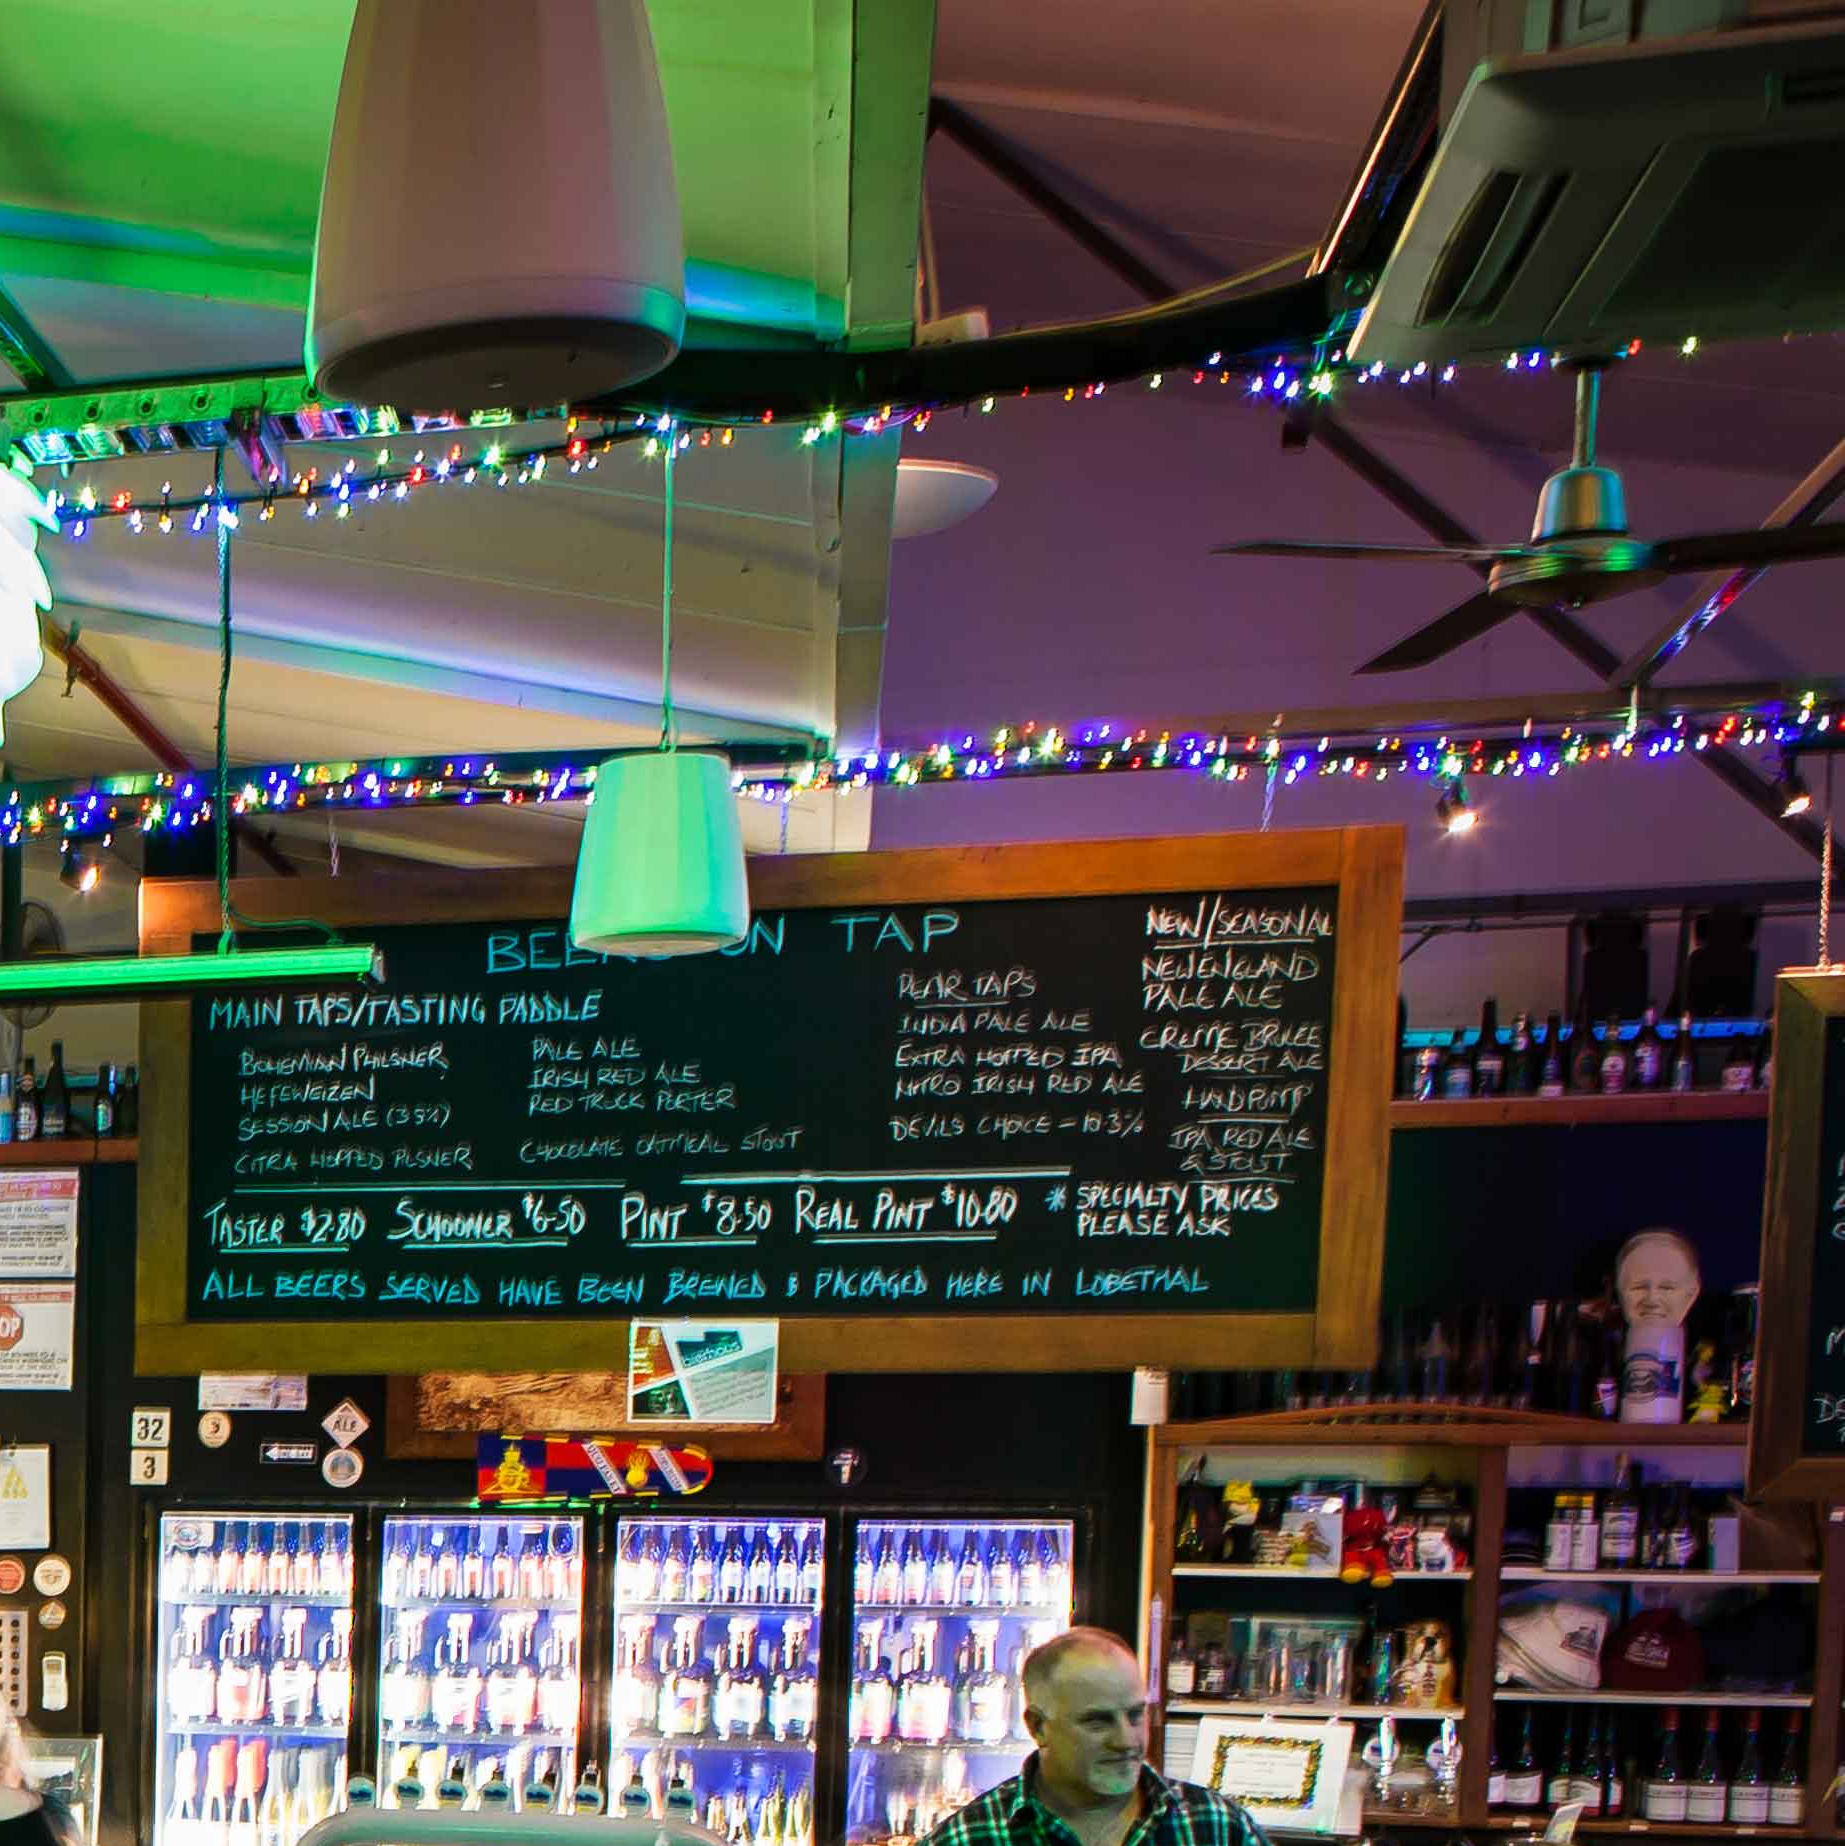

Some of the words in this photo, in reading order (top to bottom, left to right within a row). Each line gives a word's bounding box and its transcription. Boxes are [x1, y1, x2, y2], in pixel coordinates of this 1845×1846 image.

[486, 928, 672, 974] BEE
[830, 910, 960, 955] TAP
[1142, 951, 1195, 981] NEW
[1197, 949, 1319, 981] ENGLAND
[973, 965, 1038, 997] TAPS
[210, 994, 283, 1030] MAIN
[294, 992, 486, 1027] TAPS/TASTING
[498, 988, 604, 1023] PADDLE
[1143, 983, 1215, 1012] PALE
[1221, 982, 1285, 1009] ALE
[896, 1010, 966, 1035] INDIA
[974, 1009, 1031, 1032] PALE
[1040, 1008, 1092, 1032] ALE
[239, 1043, 346, 1076] BOHEMIAN
[533, 1037, 582, 1062] PALE
[591, 1034, 641, 1060] ALE
[894, 1039, 965, 1068] EXTRA
[975, 1042, 1066, 1069] HOPPED
[1071, 1041, 1124, 1069] IPA
[1277, 1051, 1323, 1072] ALE
[528, 1066, 589, 1093] IRISH
[597, 1064, 644, 1086] RED
[655, 1061, 701, 1085] ALE
[971, 1073, 1037, 1095] IRISH
[1047, 1073, 1092, 1094] RED
[1101, 1071, 1144, 1094] ALE
[241, 1075, 374, 1113] HEFEWEIZEN
[529, 1093, 573, 1117] RED
[656, 1086, 736, 1113] PORTER
[238, 1109, 328, 1140] SESSION
[333, 1109, 377, 1130] ALE
[1223, 1127, 1262, 1149] RED
[1266, 1127, 1316, 1150] ALE
[520, 1138, 623, 1164] CHOCOLATE
[741, 1125, 805, 1152] STOUT
[1076, 1182, 1188, 1212] SPECIALTY
[1200, 1183, 1279, 1211] PRICES
[621, 1192, 689, 1240] PINT
[795, 1186, 859, 1234] REAL
[873, 1187, 934, 1231] PINT
[1077, 1211, 1169, 1236] PLEASE
[1176, 1212, 1232, 1236] ASK
[203, 1269, 263, 1299] ALL
[275, 1270, 366, 1299] BEERS
[379, 1272, 481, 1303] SERVED
[499, 1275, 562, 1304] HAVE
[577, 1272, 644, 1303] BEEN
[663, 1266, 766, 1304] BREWED
[814, 1265, 929, 1298] PACKAGED
[946, 1270, 1003, 1298] HERE
[1022, 1269, 1051, 1296] IN
[1076, 1265, 1208, 1297] LOBETHAL
[137, 1417, 164, 1441] 32
[143, 1456, 156, 1479] 3
